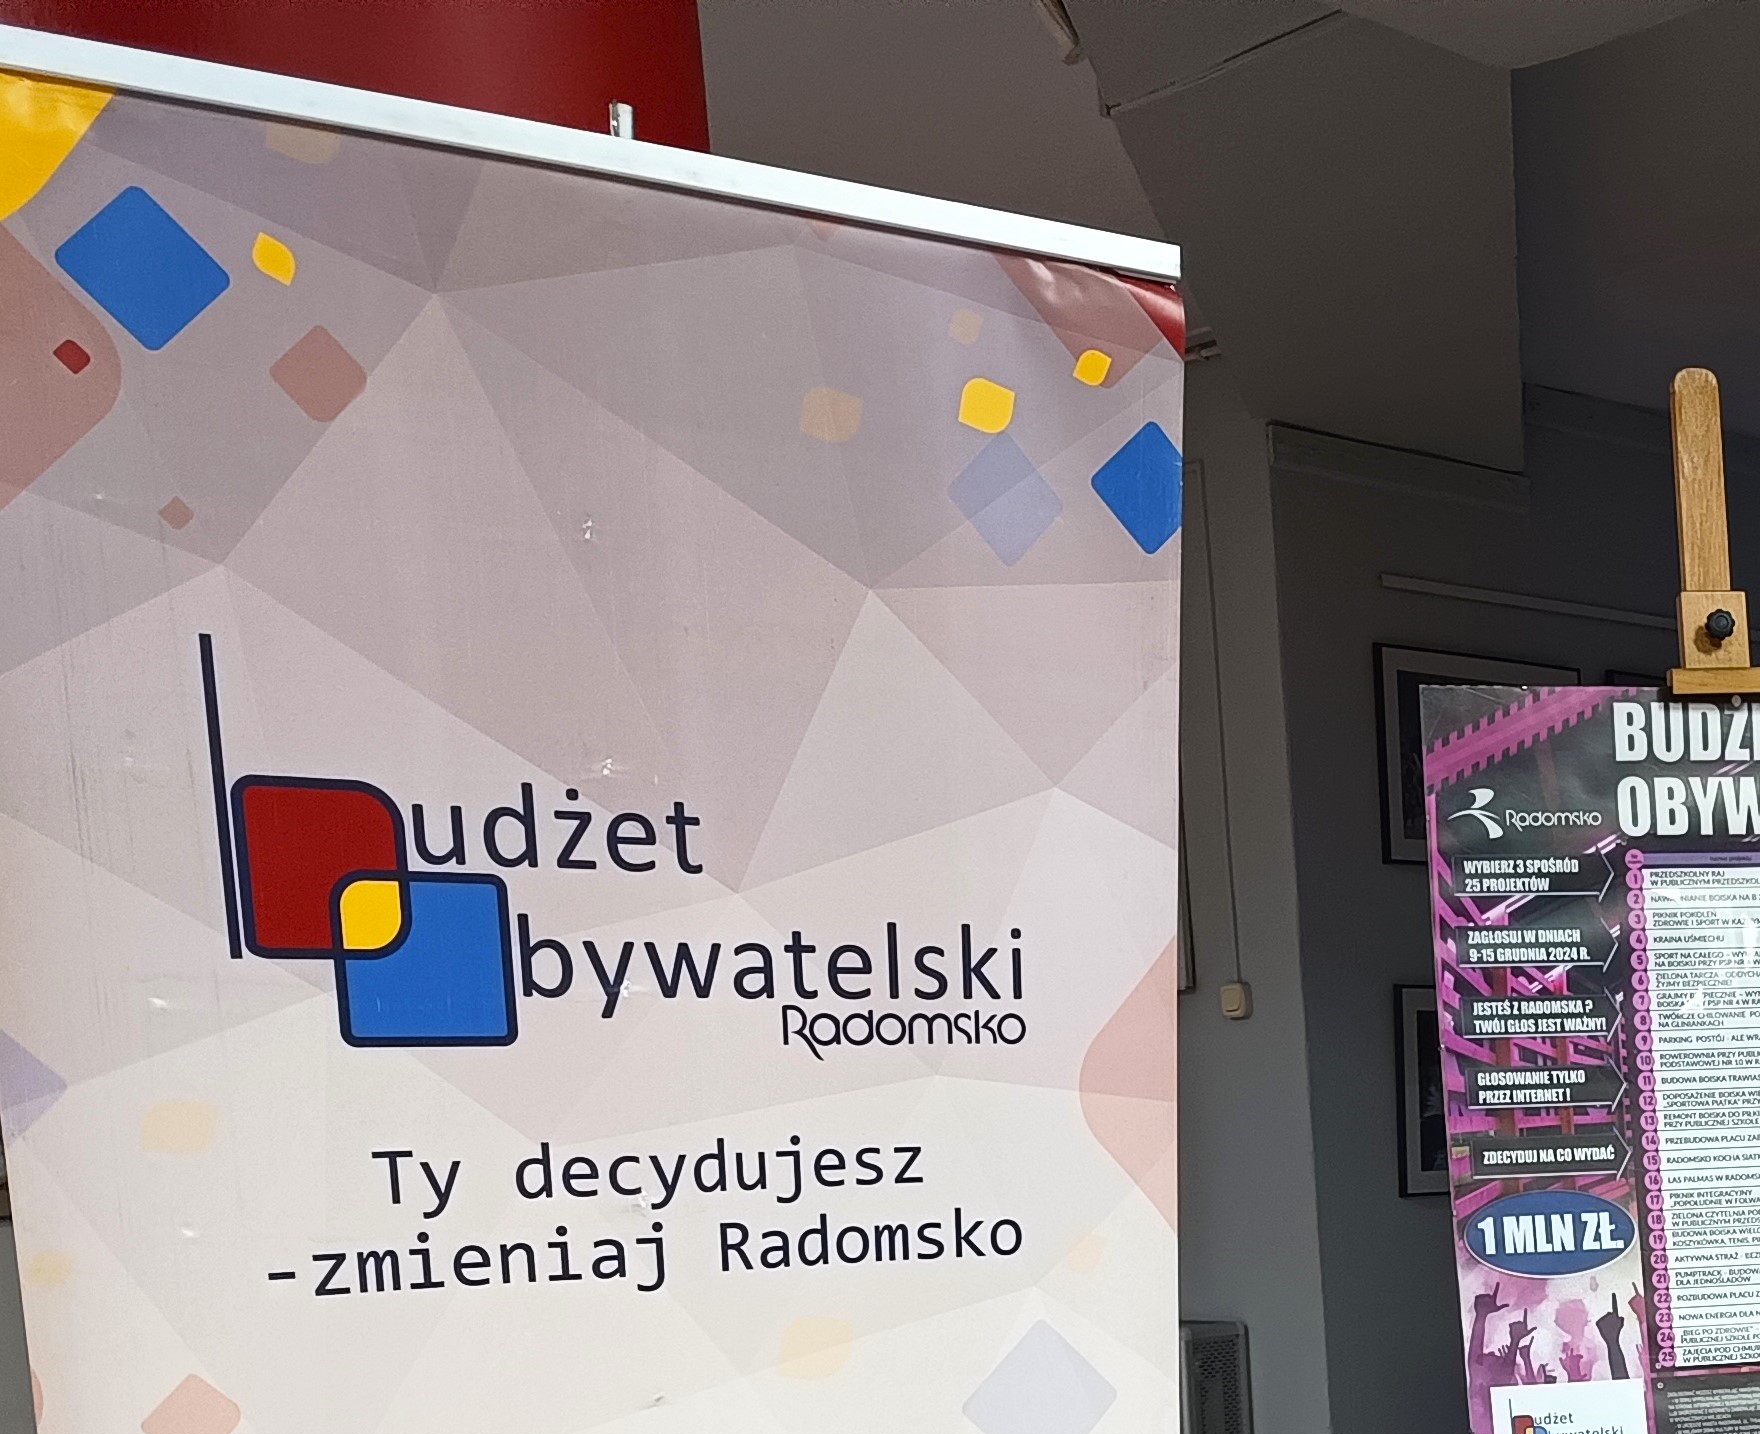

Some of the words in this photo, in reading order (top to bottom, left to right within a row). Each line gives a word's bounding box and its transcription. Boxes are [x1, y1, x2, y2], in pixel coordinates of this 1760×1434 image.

[1506, 810, 1602, 831] Radomsko
[1464, 860, 1514, 874] WYBIERZ
[1517, 860, 1524, 873] 3
[1526, 857, 1578, 873] SPOŚRÓD
[1632, 875, 1638, 884] 1
[1712, 870, 1725, 878] RAJ
[1661, 878, 1710, 886] PUBLICZNYM
[1465, 879, 1480, 892] 25
[1484, 877, 1549, 891] PROJEKTÓW
[1633, 895, 1639, 904] 2
[1634, 914, 1641, 924] 3
[1468, 931, 1522, 944] ZAGŁOSUJ
[1524, 931, 1537, 943] W
[1539, 929, 1580, 942] DNIACH
[1635, 934, 1642, 944] 4
[1653, 935, 1682, 943] KRAINA
[1684, 933, 1724, 942] UŚMIECHU
[1470, 948, 1494, 962] 9-15
[1497, 948, 1547, 961] GRUDNIA
[1549, 947, 1577, 960] 2024
[1580, 947, 1590, 960] R.
[1637, 955, 1643, 965] 5
[1638, 976, 1644, 985] 6
[1639, 995, 1645, 1005] 7
[1473, 1001, 1511, 1015] JESTEŚ
[1513, 1002, 1519, 1014] Z
[1521, 1001, 1583, 1014] RADOMSKA
[1586, 1000, 1593, 1013] ?
[1474, 1018, 1505, 1033] TWÓJ
[1507, 1020, 1535, 1032] GŁOS
[1537, 1019, 1562, 1032] JEST
[1563, 1016, 1606, 1031] WAŻNY!
[1640, 1016, 1646, 1026] 8
[781, 1005, 1027, 1061] Radomsko
[1641, 1036, 1647, 1045] 9
[1640, 1056, 1651, 1066] 10
[1478, 1072, 1550, 1086] GŁOSOWANIE
[1551, 1070, 1585, 1083] TYLKO
[1643, 1076, 1651, 1085] 11
[1661, 1076, 1697, 1084] BUDOWA
[1699, 1075, 1726, 1083] BOISKA
[1479, 1090, 1511, 1103] PRZEZ
[1513, 1089, 1564, 1103] INTERNET
[1566, 1089, 1570, 1101] !
[1643, 1096, 1654, 1106] 12
[1645, 1116, 1655, 1126] 13
[1645, 1136, 1656, 1146] 14
[1665, 1136, 1719, 1145] PRZEBUDOWA
[1721, 1134, 1746, 1142] PLACU
[1483, 1151, 1537, 1164] ZDECYDUJ
[1540, 1150, 1555, 1163] NA
[1557, 1149, 1572, 1161] CO
[1574, 1145, 1615, 1160] WYDAĆ
[1647, 1156, 1657, 1166] 15
[1667, 1155, 1711, 1164] RADOMSKO
[372, 1150, 461, 1219] Ty
[515, 1135, 924, 1209] decydujesz
[1648, 1175, 1659, 1185] 16
[1683, 1175, 1714, 1183] PALMAS
[1650, 1196, 1660, 1206] 17
[1651, 1215, 1661, 1225] 18
[1478, 1217, 1496, 1254] 1
[1503, 1214, 1575, 1254] MLN
[1652, 1235, 1663, 1245] 19
[267, 1223, 668, 1295] -zmieniaj
[720, 1208, 1023, 1272] Radomsko
[1654, 1255, 1666, 1264] 20
[1657, 1274, 1666, 1284] 21
[1657, 1294, 1669, 1304] 22
[1677, 1292, 1728, 1301] ROZBUDOWA
[1730, 1291, 1754, 1299] PLACU
[1658, 1313, 1671, 1323] 23
[1705, 1311, 1738, 1320] ENERGIA
[1739, 1310, 1753, 1318] DLA
[1660, 1333, 1673, 1342] 24
[1661, 1353, 1674, 1362] 25
